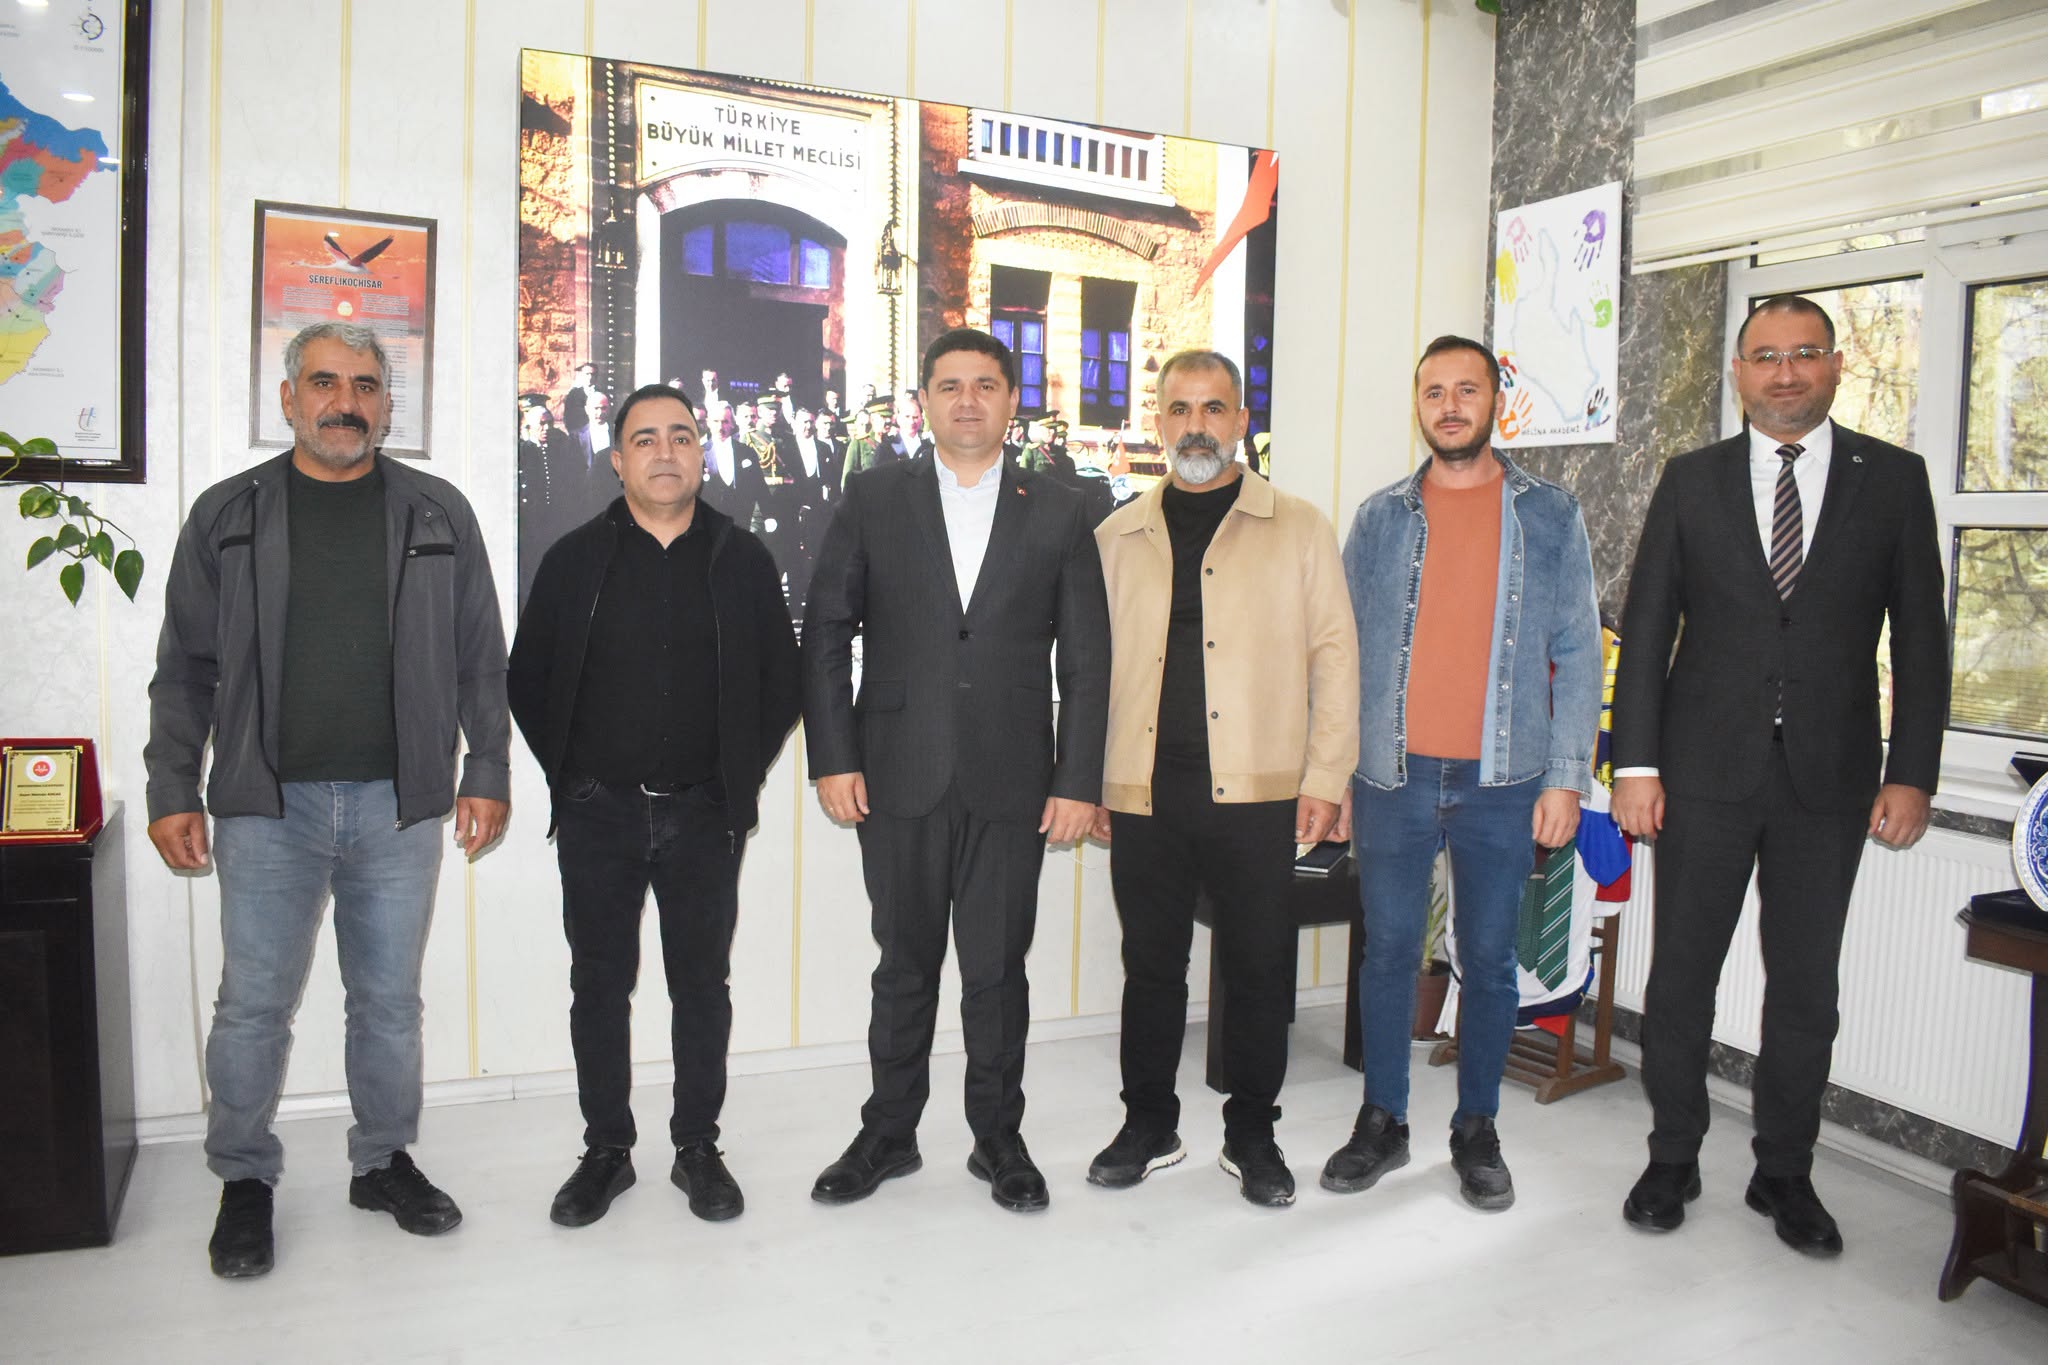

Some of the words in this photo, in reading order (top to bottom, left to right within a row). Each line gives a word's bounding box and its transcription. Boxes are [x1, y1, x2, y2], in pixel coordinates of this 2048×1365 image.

[714, 105, 801, 135] TÜRKİYE
[647, 121, 714, 148] BÜYÜK
[724, 133, 785, 159] MİLLET
[793, 145, 861, 170] MECLİSİ
[309, 274, 383, 289] ŞEREFLİKOÇHİSAR
